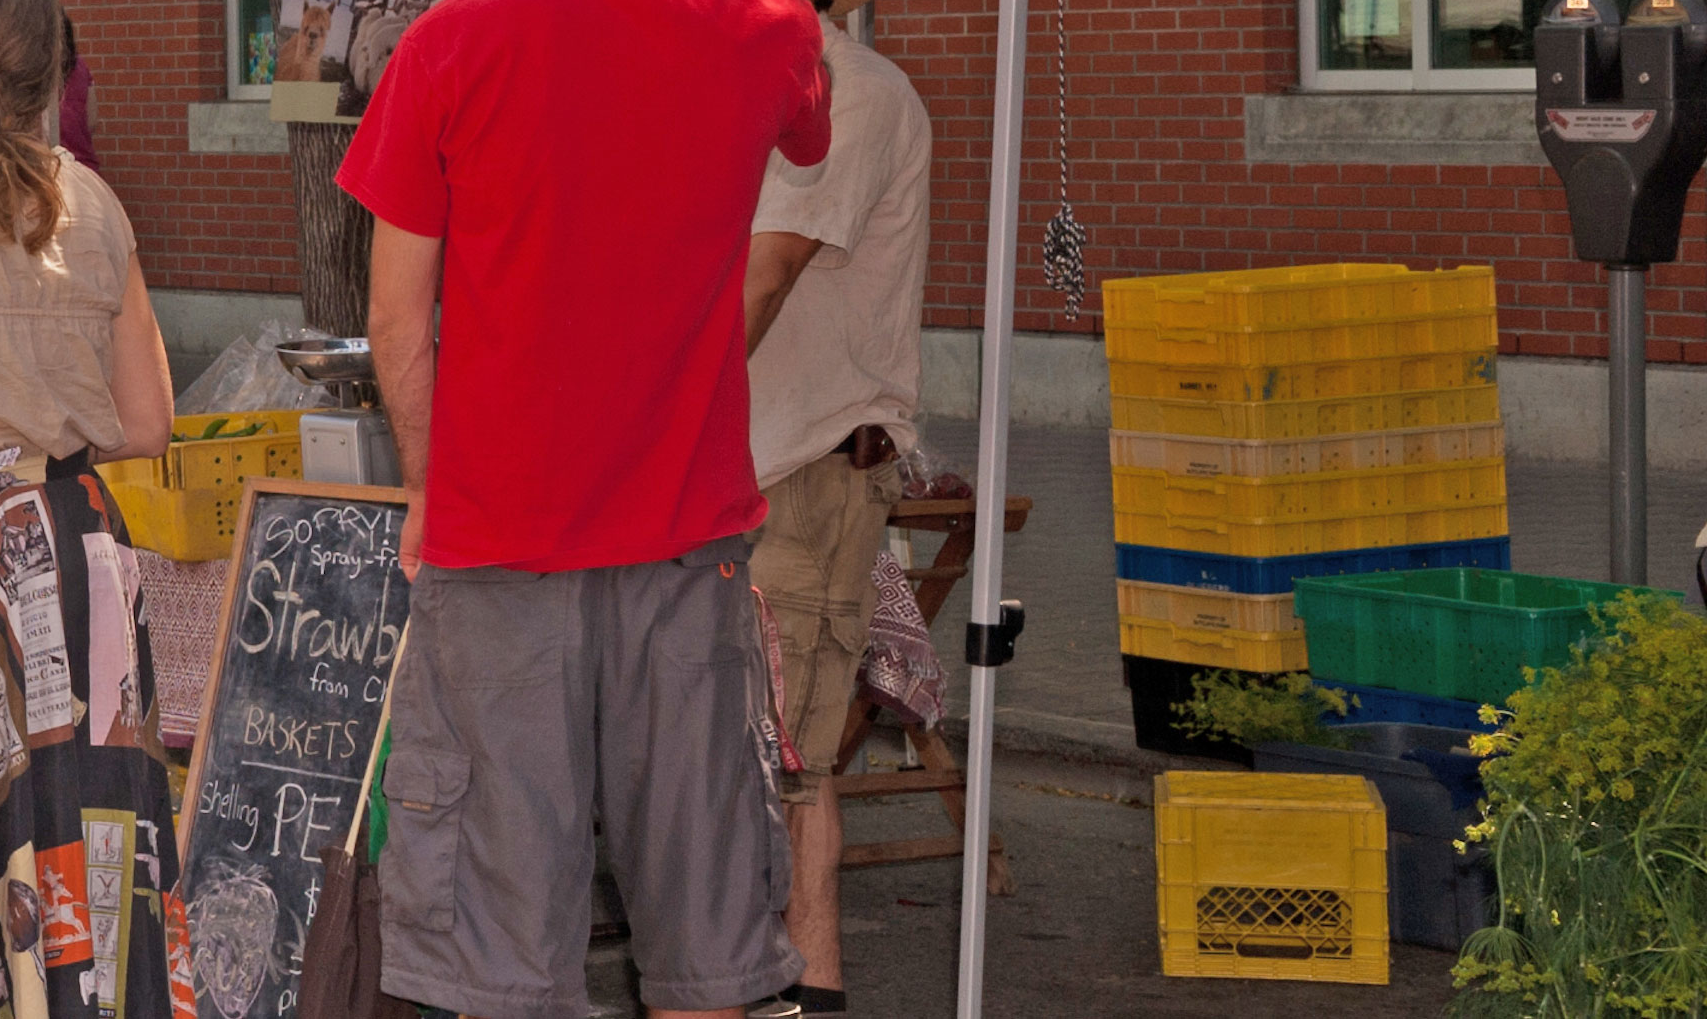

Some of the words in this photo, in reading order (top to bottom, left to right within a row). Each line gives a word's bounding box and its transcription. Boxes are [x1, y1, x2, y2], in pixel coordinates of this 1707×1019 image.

[266, 505, 392, 559] SORRY!
[310, 662, 348, 698] from
[245, 705, 358, 759] BASKETS
[200, 780, 259, 852] Shelling
